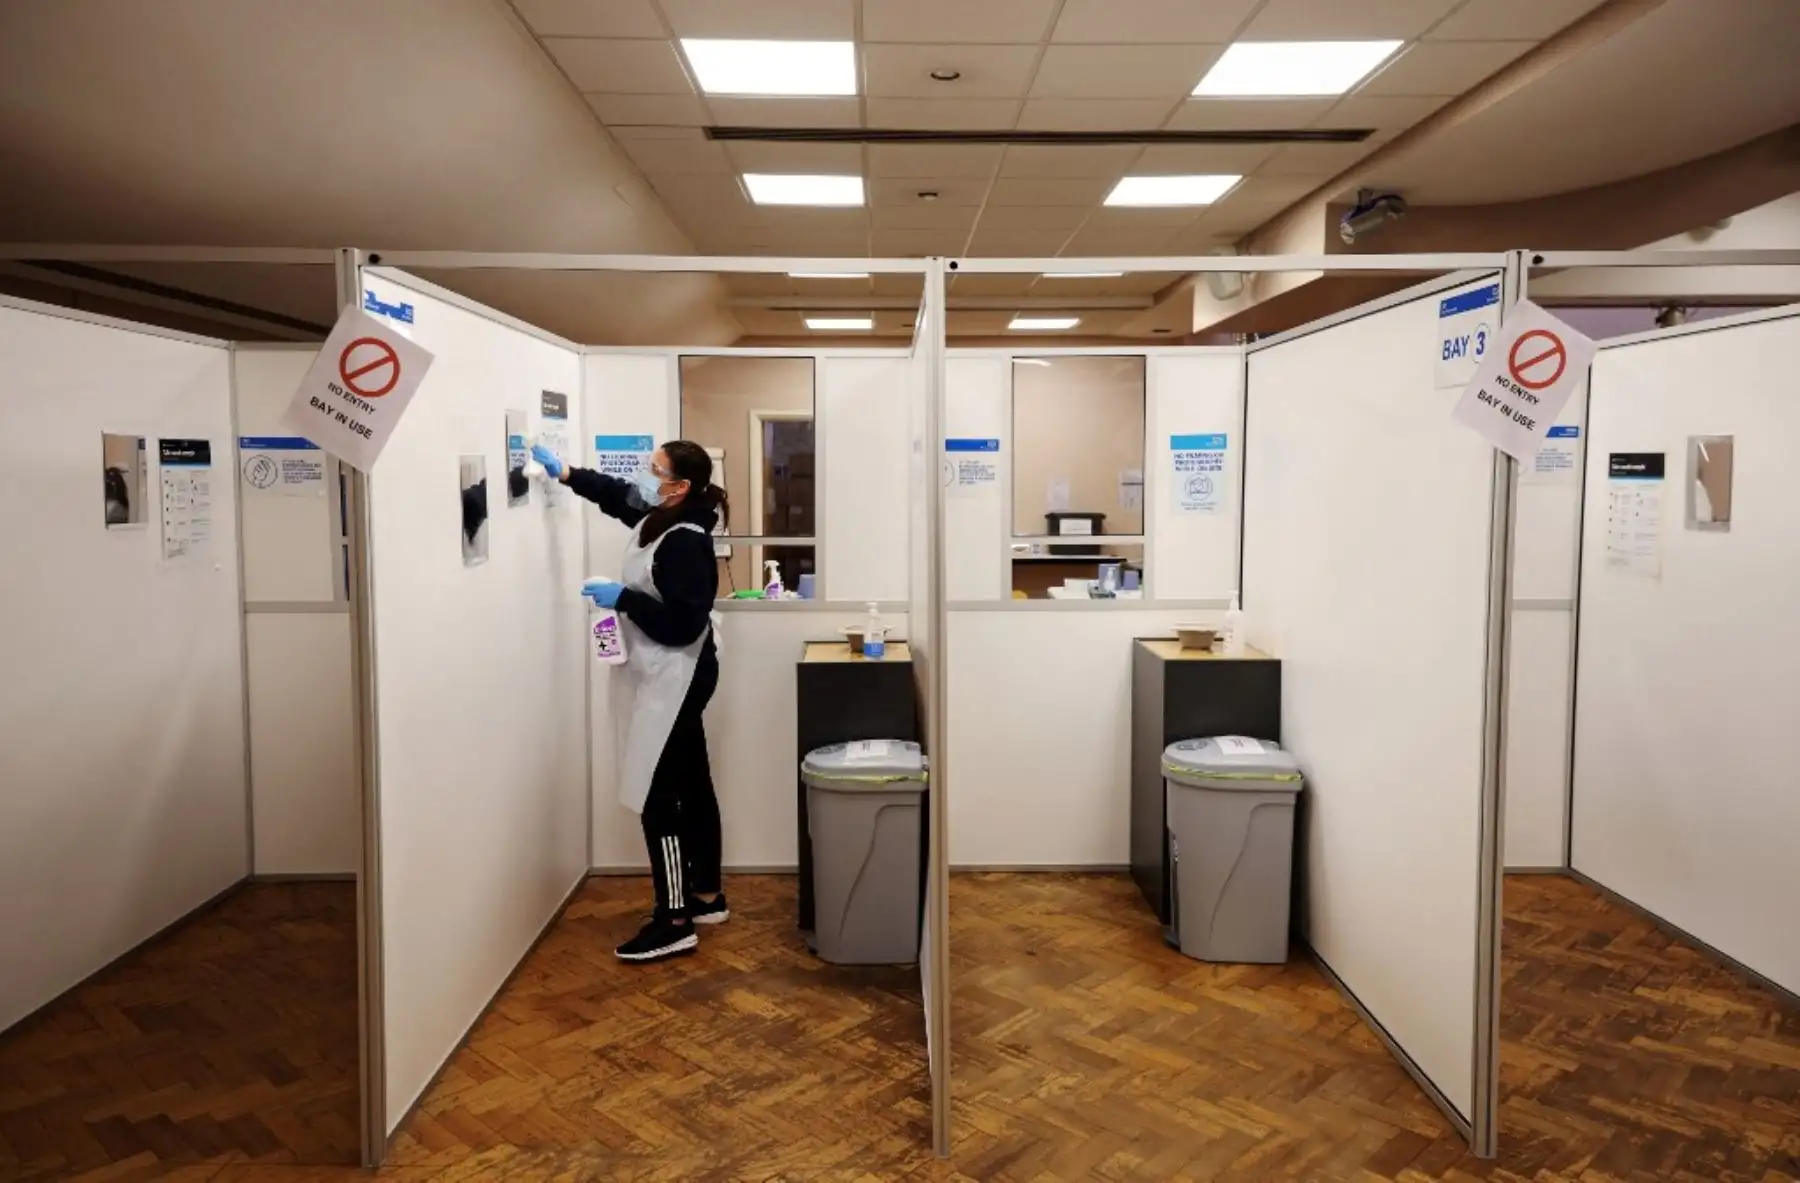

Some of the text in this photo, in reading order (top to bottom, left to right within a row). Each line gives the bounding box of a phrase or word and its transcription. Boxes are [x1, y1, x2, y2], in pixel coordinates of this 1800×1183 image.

[1442, 331, 1487, 361] BAY 3
[328, 382, 377, 415] NO ENTRY
[1495, 375, 1541, 406] NO ENTRY
[310, 396, 374, 440] BAY IN USE
[1477, 389, 1537, 431] BAY IN USE
